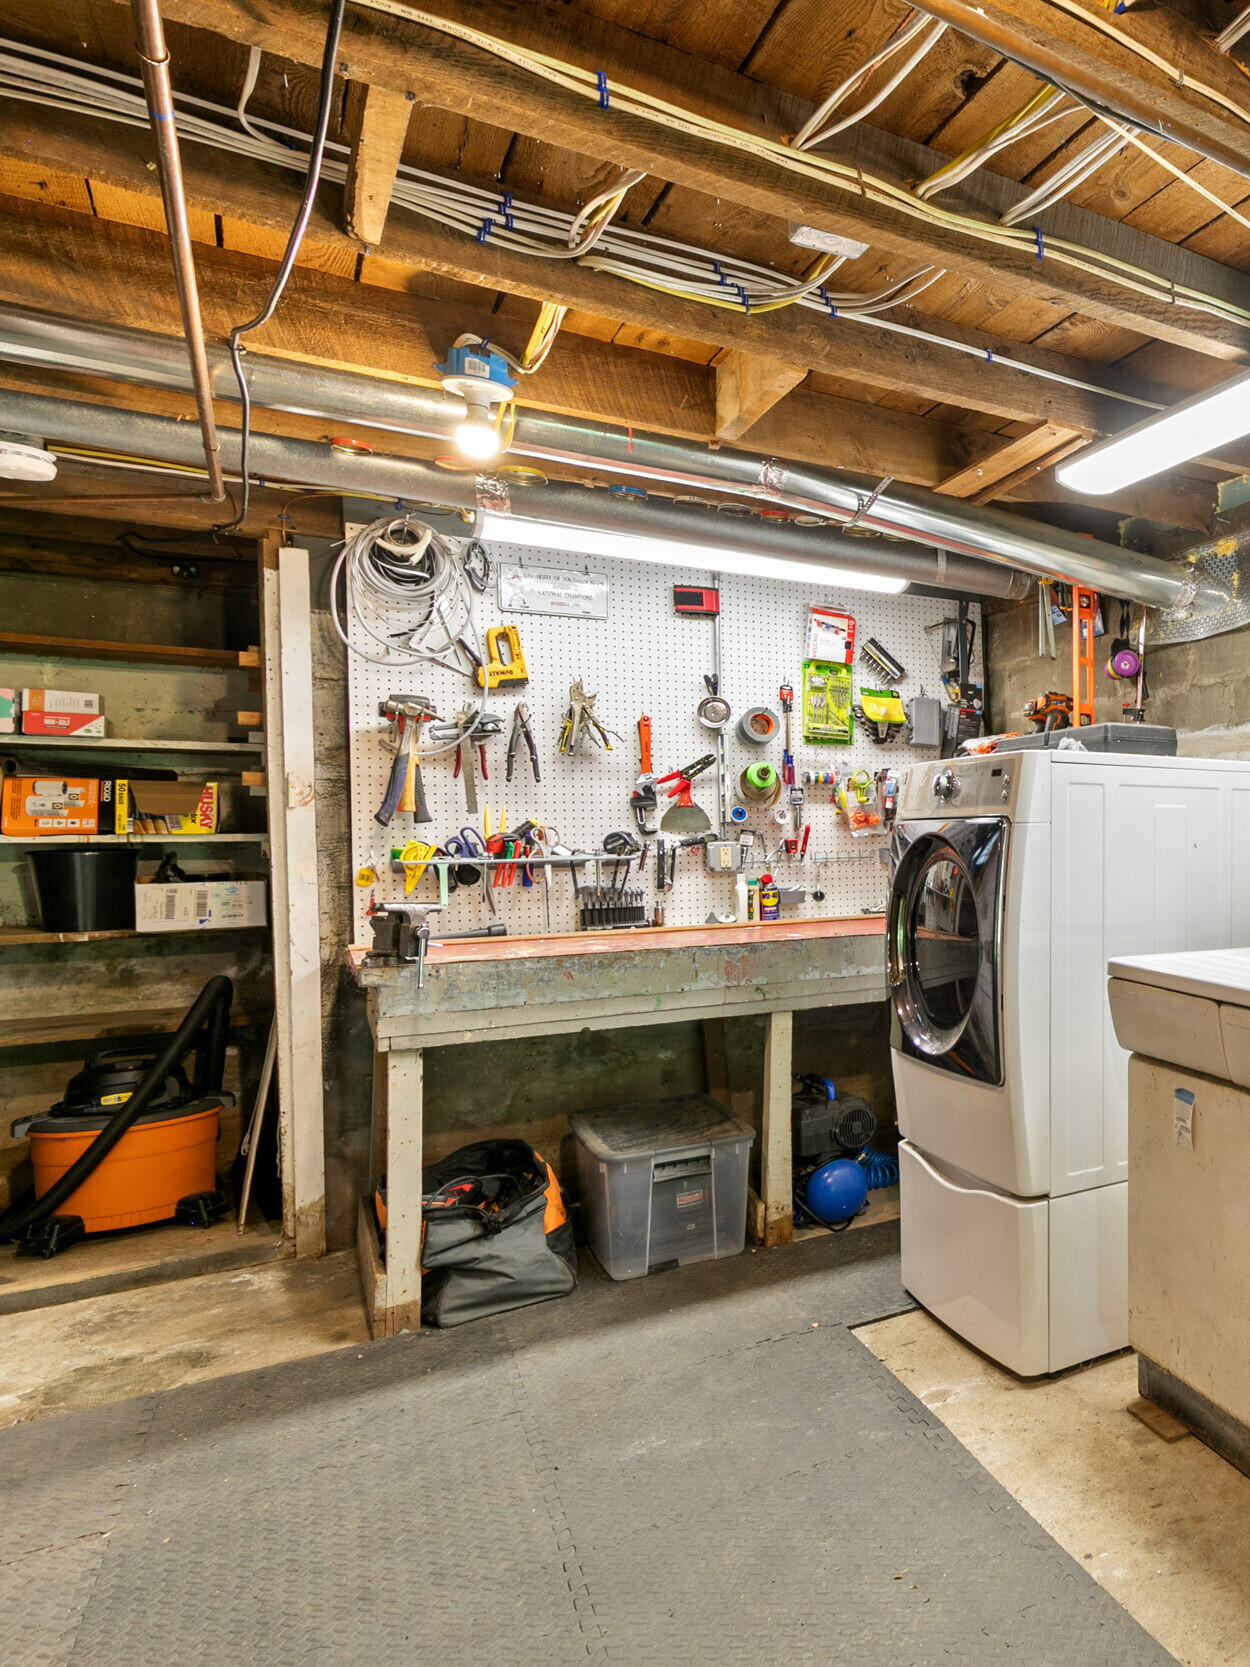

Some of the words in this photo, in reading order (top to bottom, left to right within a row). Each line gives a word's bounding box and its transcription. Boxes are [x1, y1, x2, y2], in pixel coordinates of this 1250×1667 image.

[103, 780, 112, 802] RIDGID
[118, 783, 127, 792] 50
[199, 785, 214, 830] HUSKY
